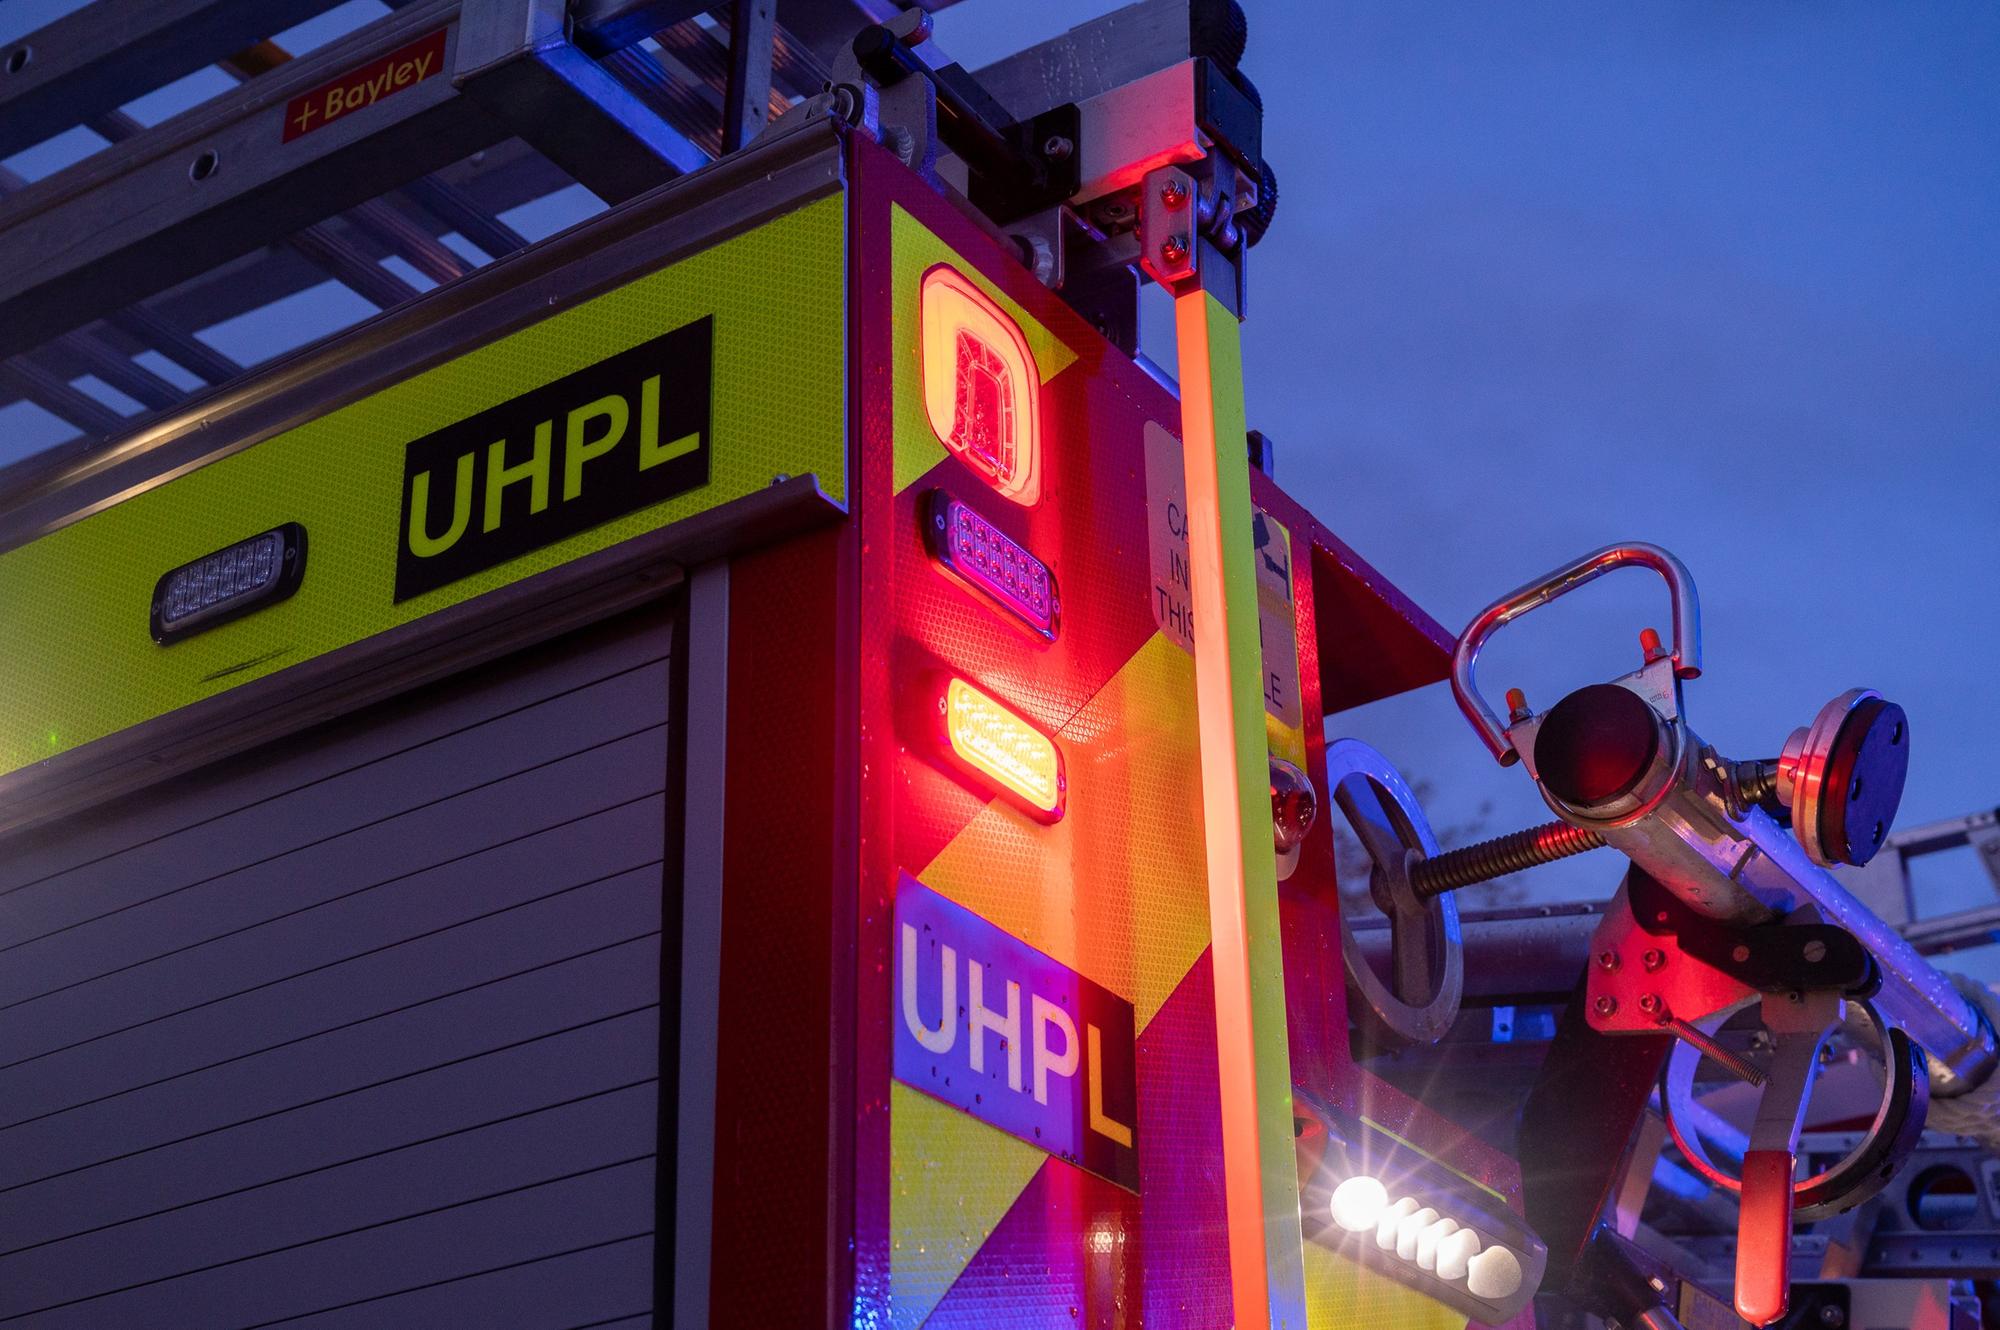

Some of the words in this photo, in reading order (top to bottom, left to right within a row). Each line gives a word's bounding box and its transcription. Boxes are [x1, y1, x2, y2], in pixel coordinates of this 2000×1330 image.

[324, 50, 434, 120] Bayley
[408, 374, 700, 558] UHPL
[902, 921, 1132, 1149] UHPL
